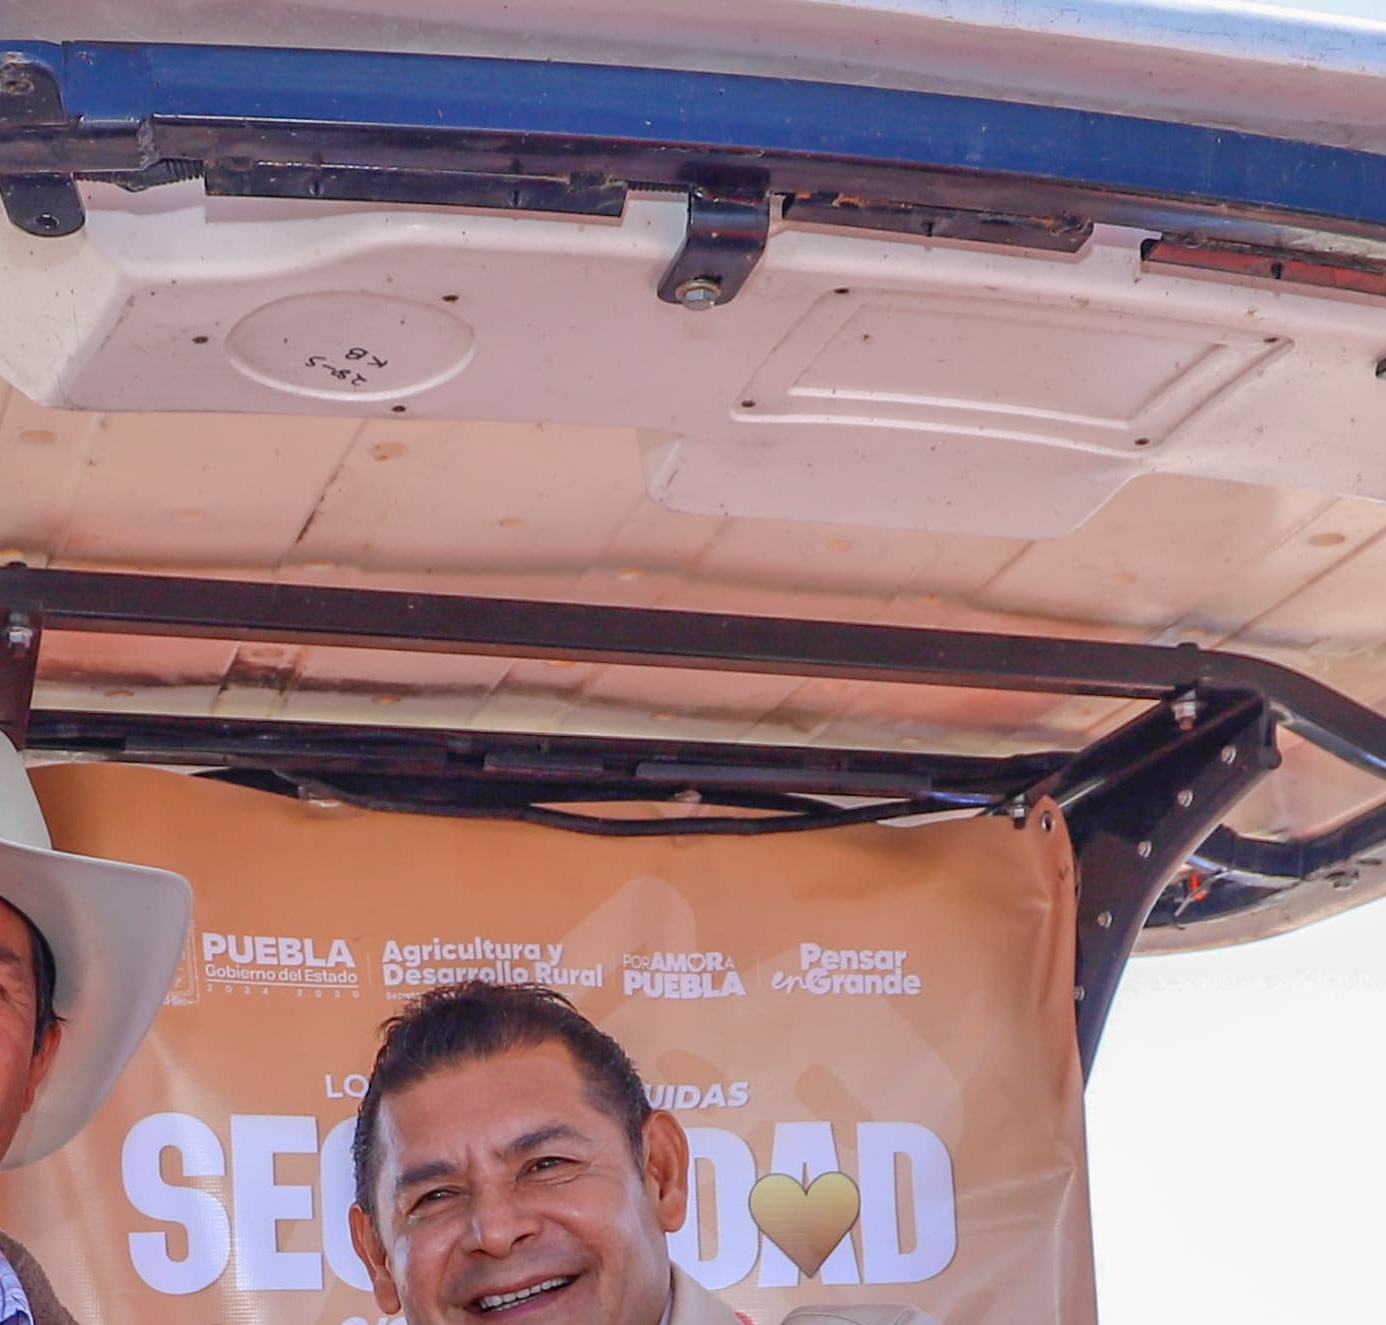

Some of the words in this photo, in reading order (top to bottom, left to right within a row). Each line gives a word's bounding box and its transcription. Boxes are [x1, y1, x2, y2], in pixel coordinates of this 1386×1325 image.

[202, 932, 357, 968] PUEBLA
[382, 936, 541, 967] Agricultura
[547, 943, 564, 964] y
[800, 942, 908, 971] Pensar
[205, 964, 276, 981] Gobierno
[278, 968, 302, 982] del
[304, 969, 358, 984] Estado
[383, 961, 529, 986] Desarrollo
[533, 960, 603, 988] Rural
[623, 970, 747, 1000] PUEBLA
[772, 969, 811, 993] en
[807, 967, 921, 995] Grande
[325, 1073, 370, 1099] LO
[644, 1082, 750, 1110] UIDAS
